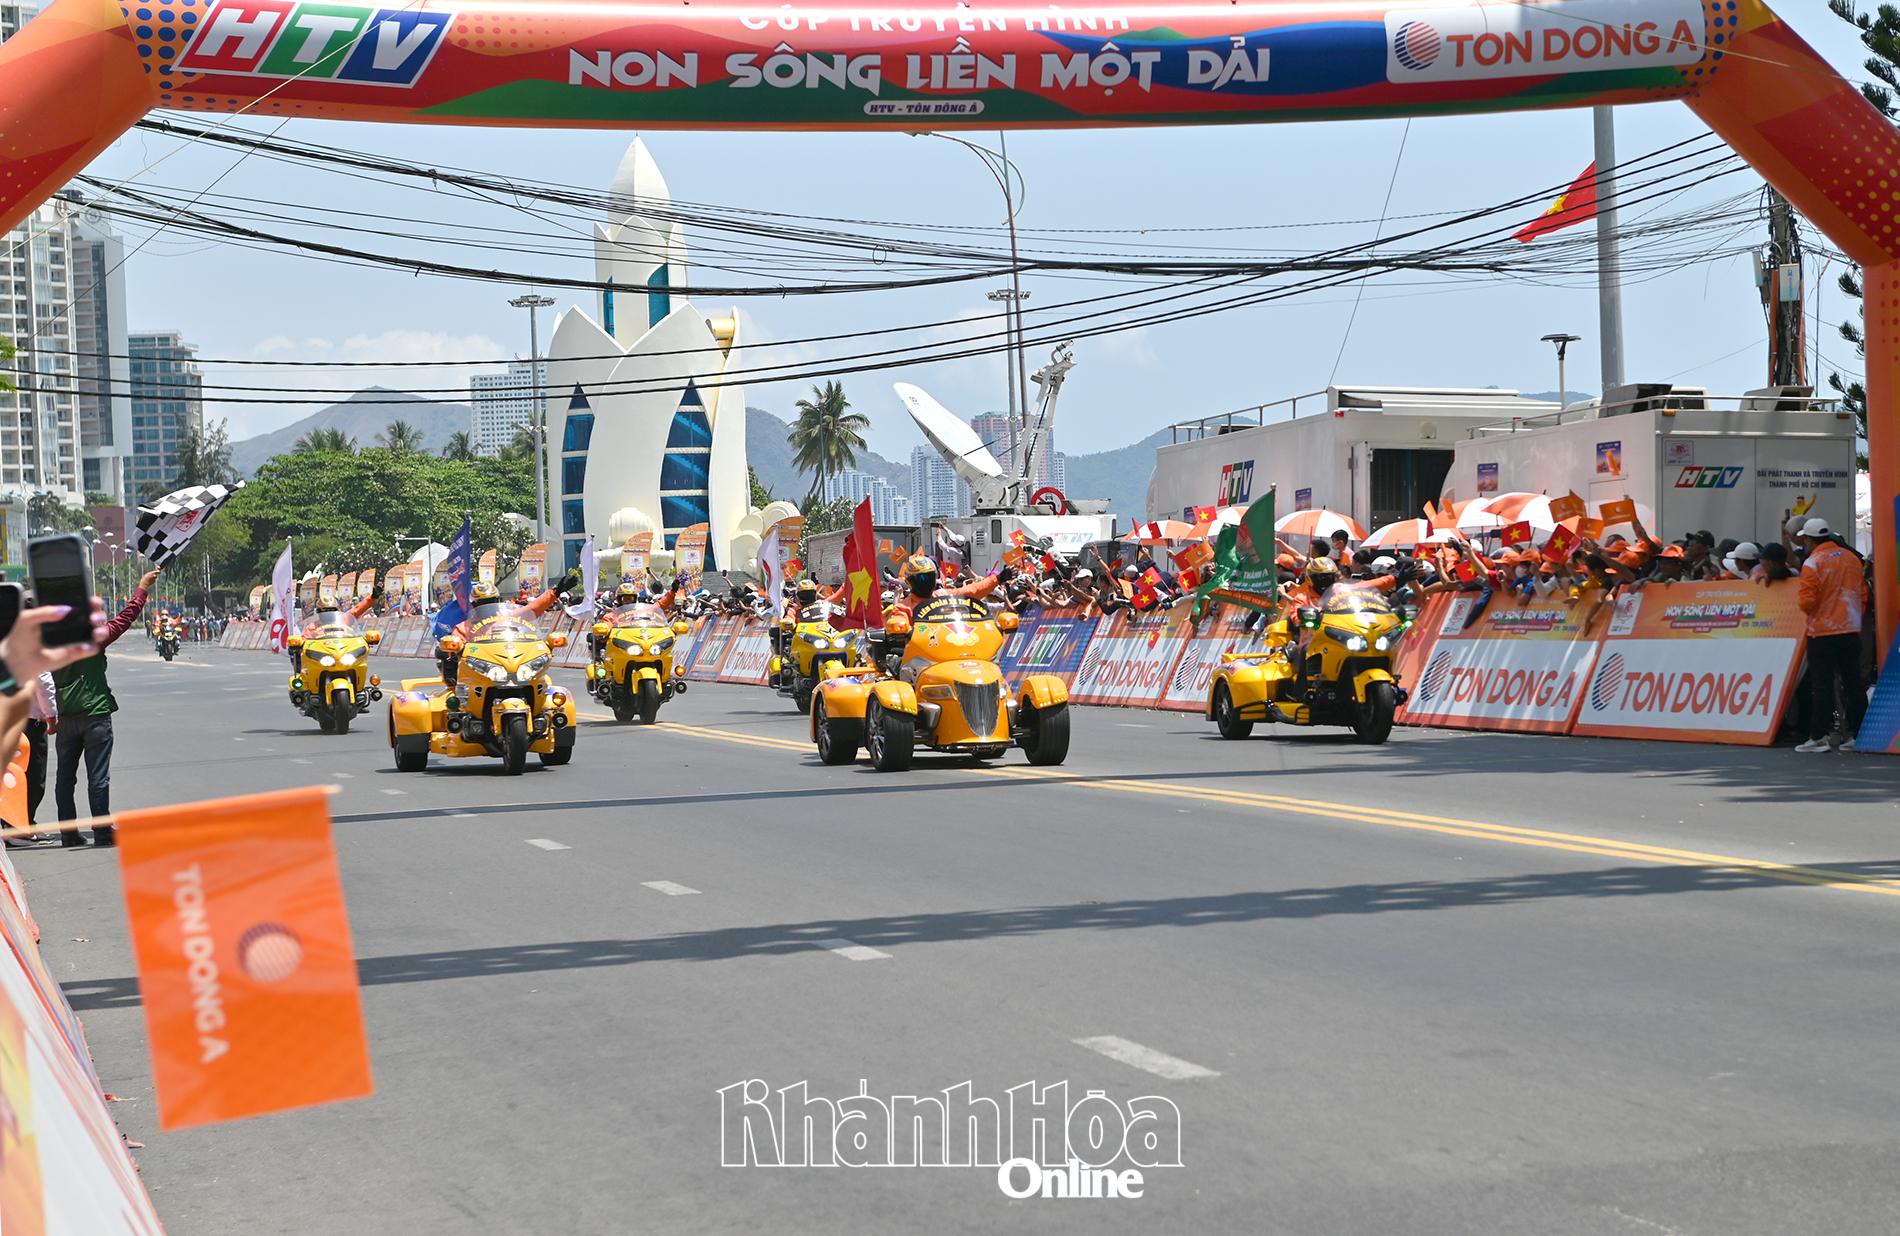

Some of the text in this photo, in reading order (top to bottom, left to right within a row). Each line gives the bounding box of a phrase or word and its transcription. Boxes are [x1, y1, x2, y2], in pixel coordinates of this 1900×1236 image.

[195, 7, 438, 71] HTV
[1446, 18, 1698, 67] TON DONG A
[568, 36, 1271, 97] NON SÔNG LIỀN MỘT DẢI
[869, 104, 895, 113] HTV
[906, 102, 931, 113] TÔN
[1219, 465, 1253, 502] HTV
[1679, 469, 1738, 487] HTV
[1022, 631, 1068, 659] HTV
[1092, 660, 1169, 688] TON DONG A
[1443, 667, 1577, 708] TON DONG A
[1619, 671, 1774, 717] TON DONG A
[172, 862, 231, 1065] TON DONG A
